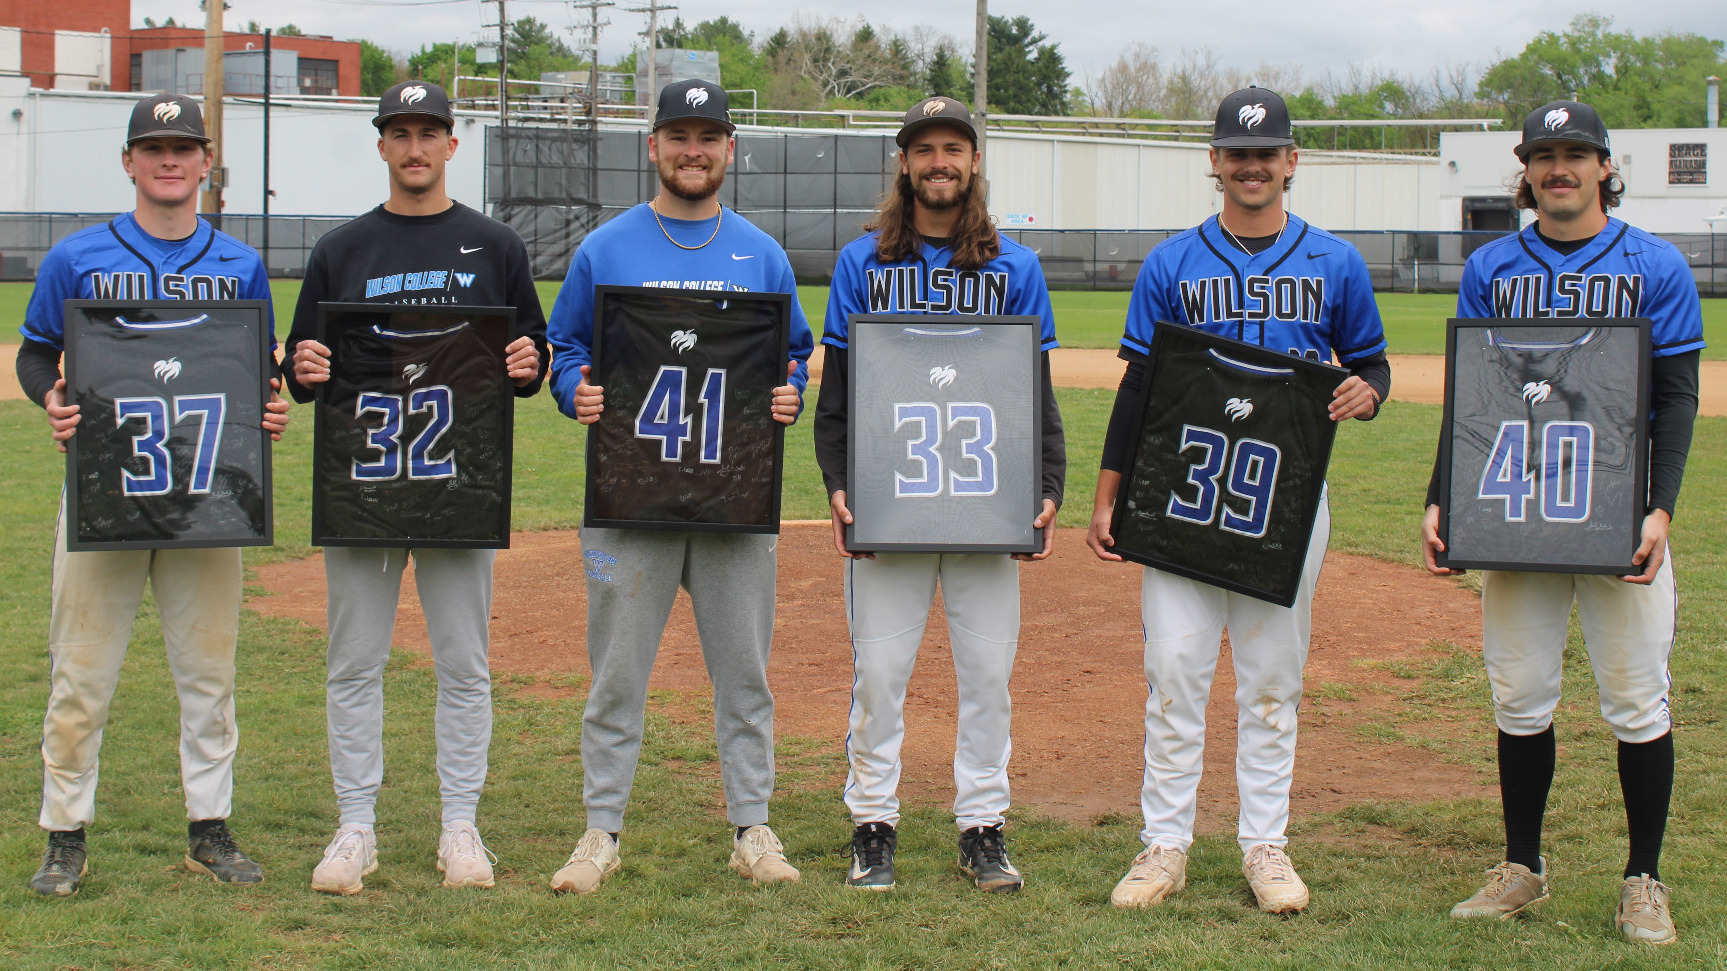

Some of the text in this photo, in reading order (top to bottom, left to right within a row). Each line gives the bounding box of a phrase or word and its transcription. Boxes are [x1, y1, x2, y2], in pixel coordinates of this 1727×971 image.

[1670, 144, 1706, 158] SPACE
[91, 272, 239, 300] WILSON
[365, 270, 476, 298] WILSON COLLEGE W
[384, 296, 458, 305] SEBALL
[866, 266, 1009, 316] WILSON
[1179, 275, 1325, 326] WILSON
[1493, 272, 1643, 318] WILSON
[350, 384, 457, 481] 32
[634, 365, 727, 464] 41
[114, 392, 227, 497] 37
[893, 401, 998, 498] 33
[1165, 424, 1281, 538] 39
[1478, 419, 1595, 524] 40
